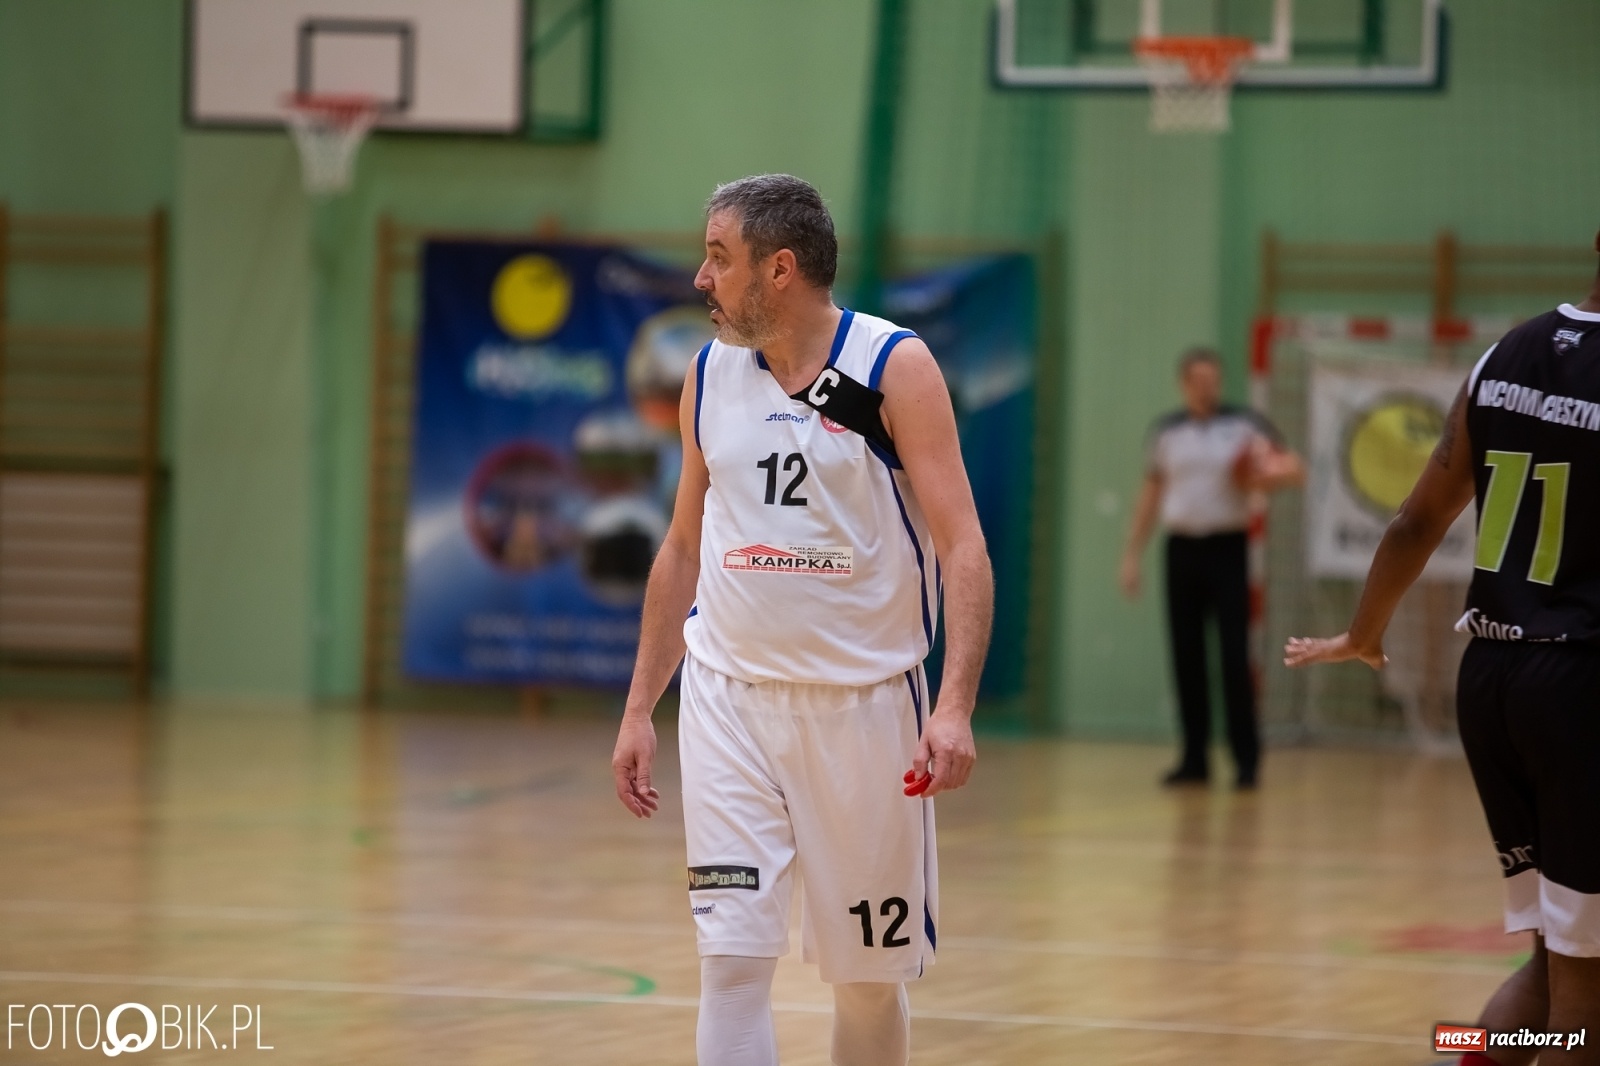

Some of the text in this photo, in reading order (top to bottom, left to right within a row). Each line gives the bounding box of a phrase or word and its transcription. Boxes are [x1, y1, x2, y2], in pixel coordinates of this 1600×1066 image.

[808, 368, 840, 406] C
[756, 452, 808, 506] 12
[1474, 450, 1571, 586] 11
[751, 556, 834, 569] KAMPKA
[848, 897, 910, 948] 12
